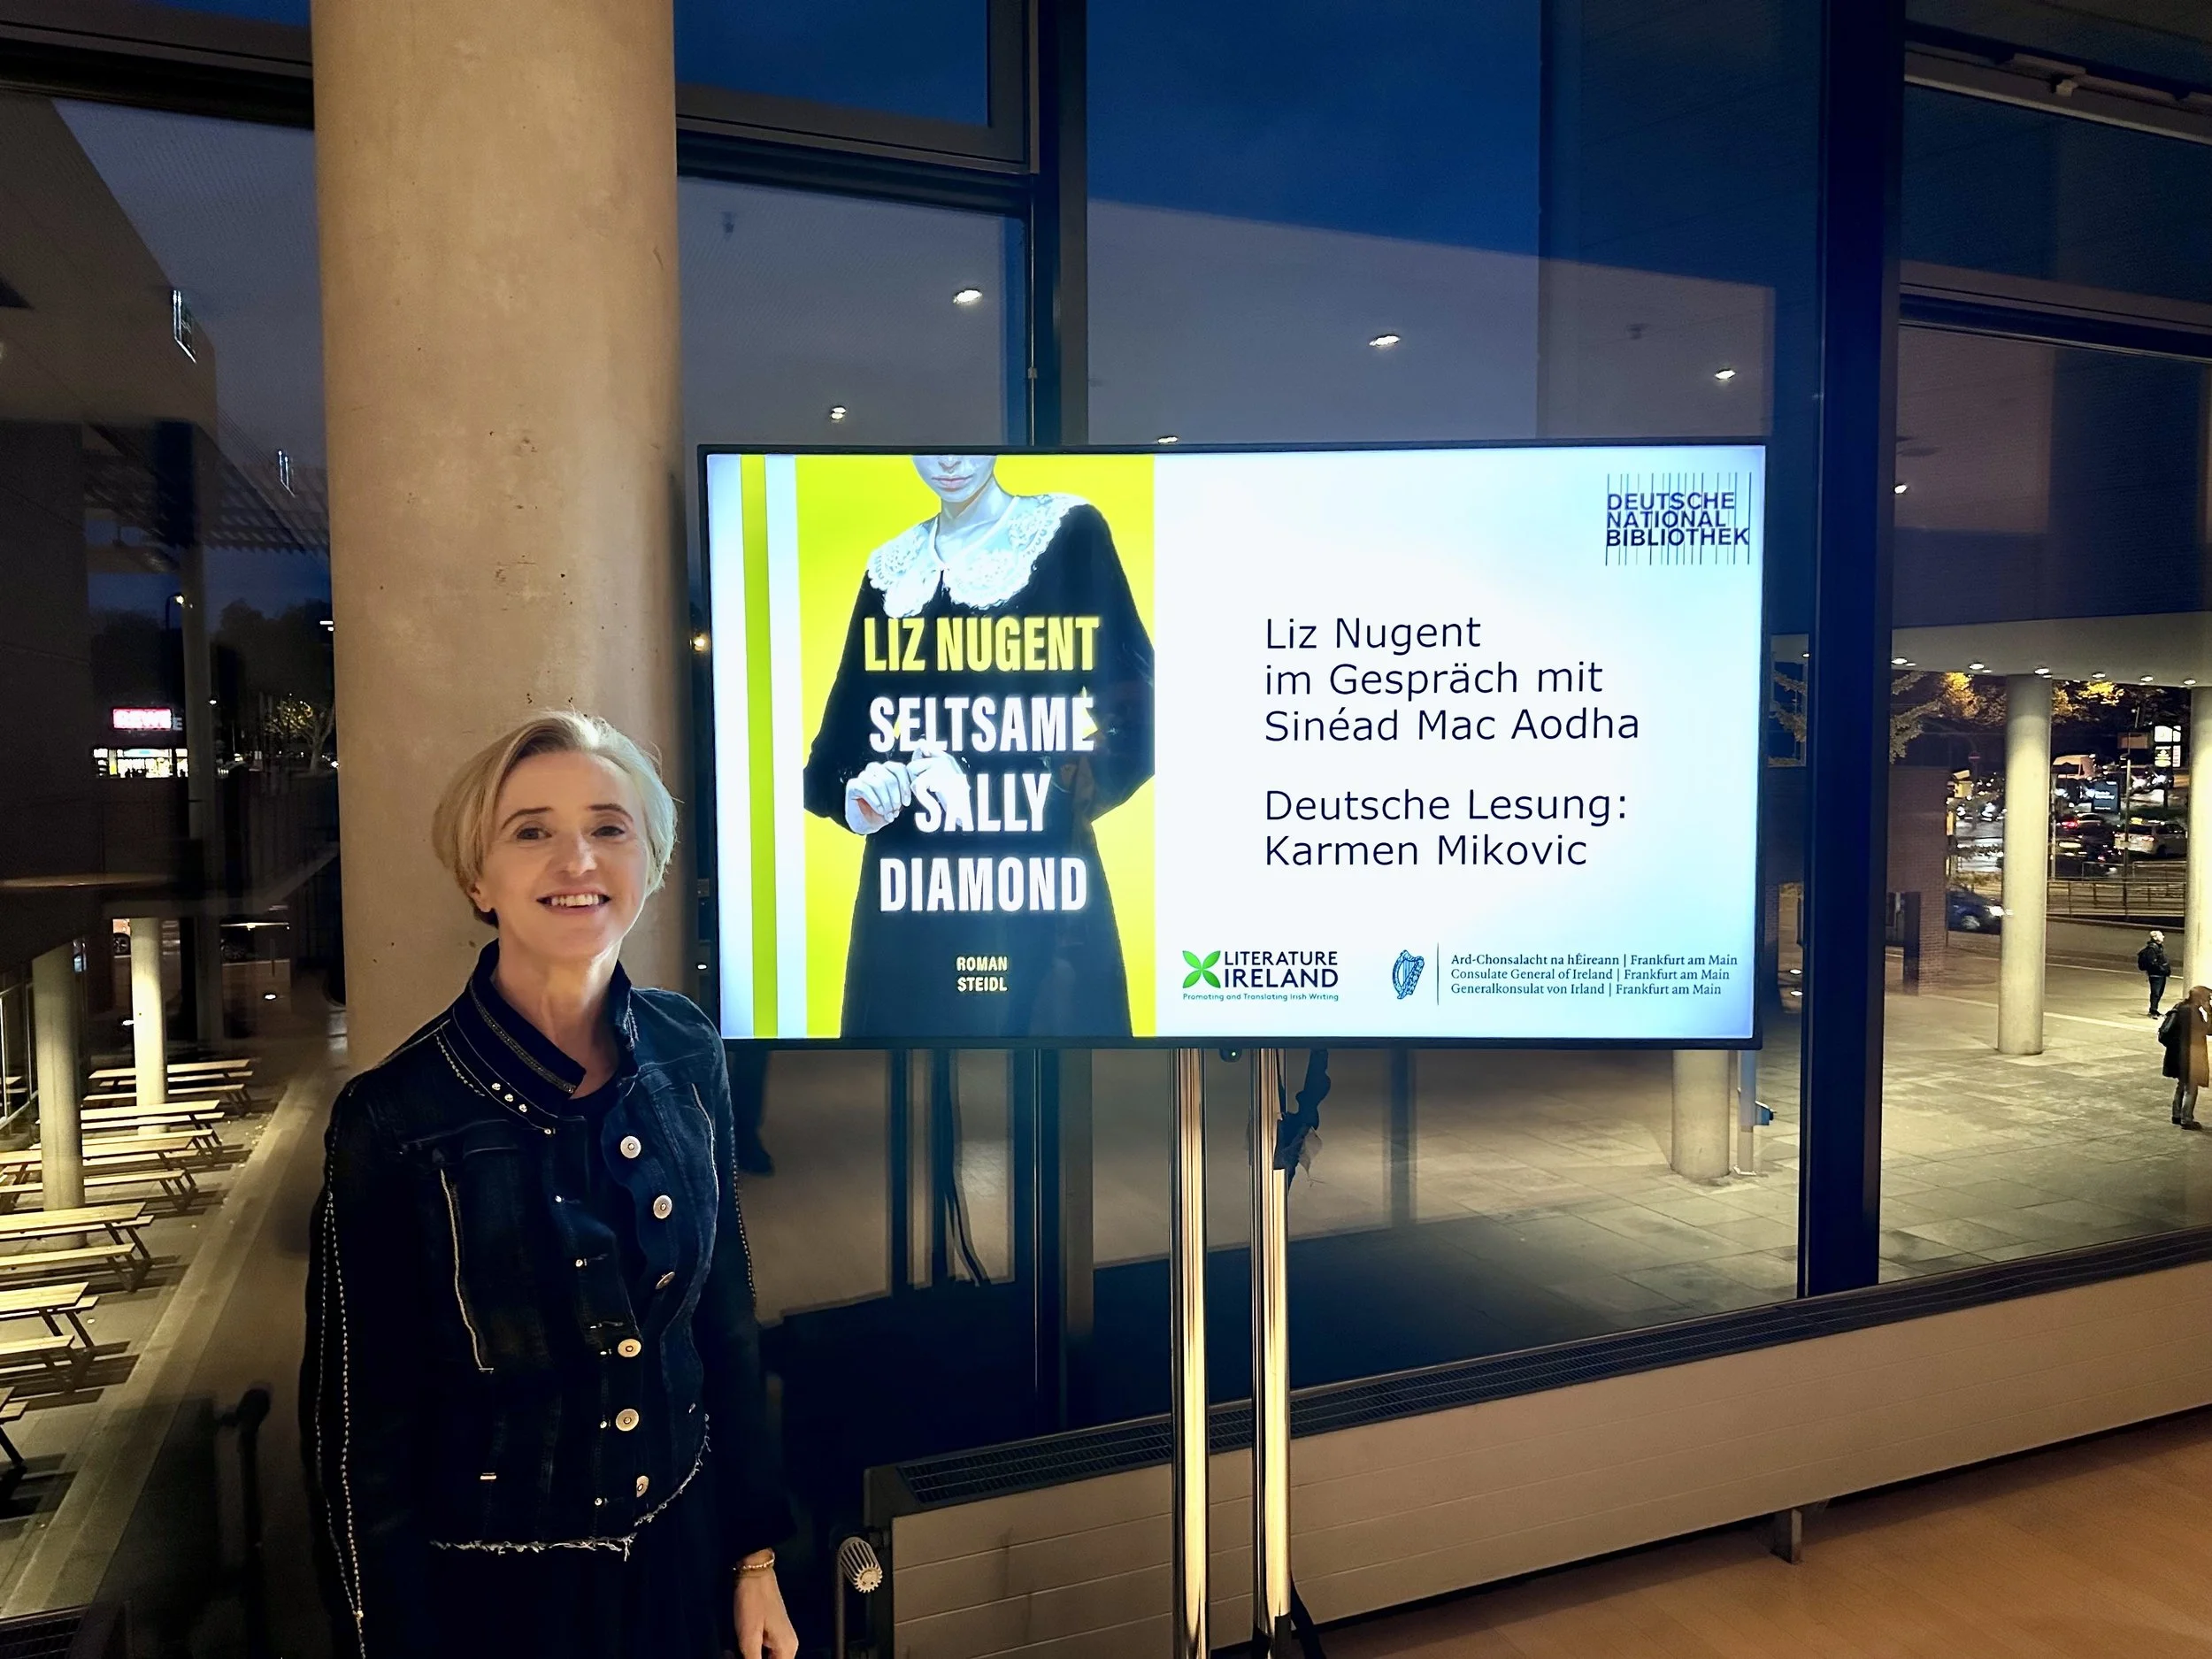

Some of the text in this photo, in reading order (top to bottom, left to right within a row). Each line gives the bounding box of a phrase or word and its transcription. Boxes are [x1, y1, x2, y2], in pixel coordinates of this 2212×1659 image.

[1607, 492, 1734, 511] DEUTSCHE
[1607, 511, 1726, 528] NATIONAL
[1607, 528, 1749, 547] BIBLIOTHEK
[864, 617, 1100, 672] LIZ NUGENT
[1266, 617, 1481, 656] Liz Nugent
[1266, 662, 1602, 702] im Gespräch mit
[869, 696, 1095, 752] SELTSAME
[1265, 707, 1640, 741] Sinéad Mac Aodha
[914, 773, 1052, 833] SALLY
[1266, 788, 1626, 826] Deutsche Lesung:
[1266, 834, 1587, 866] Karmen Mikovic
[879, 857, 1087, 911] DIAMOND
[956, 956, 1008, 972] ROMAN
[1225, 951, 1338, 965] LITERATURE
[1451, 954, 1548, 965] Ard-Chonsalacht
[1550, 956, 1564, 965] na
[1567, 953, 1619, 965] hÉireann
[1631, 954, 1685, 965] Frankfurt
[1709, 954, 1738, 965] Main
[1225, 968, 1339, 988] IRELAND
[1451, 968, 1508, 979] Consulate
[1510, 968, 1555, 979] General
[1558, 968, 1571, 979] of
[1572, 968, 1613, 979] Ireland
[1624, 968, 1678, 979] Frankfurt
[1701, 969, 1730, 979] Main
[957, 977, 1008, 992] STEIDL
[1451, 983, 1545, 994] Generalkonsulat
[1571, 983, 1604, 994] Irland
[1616, 984, 1669, 995] Frankfurt
[1693, 984, 1721, 995] Main
